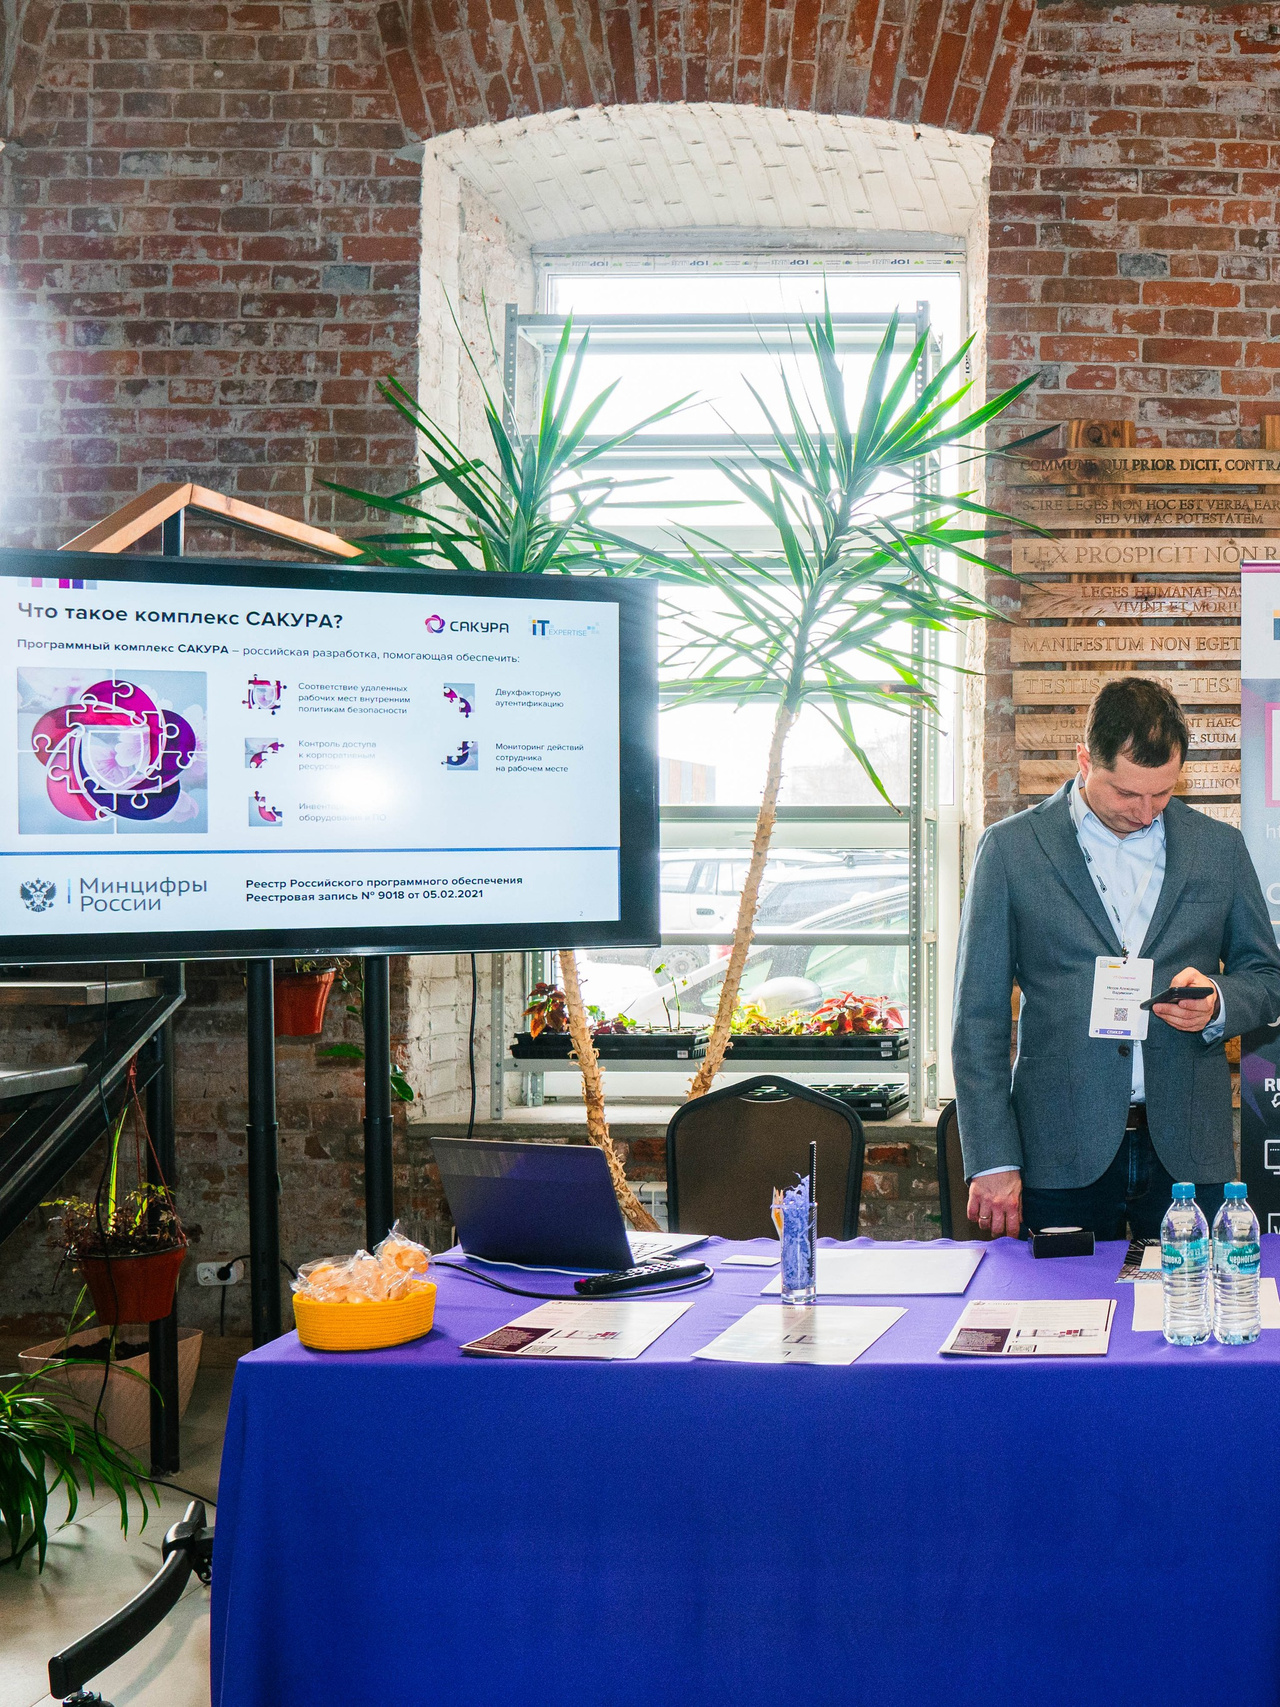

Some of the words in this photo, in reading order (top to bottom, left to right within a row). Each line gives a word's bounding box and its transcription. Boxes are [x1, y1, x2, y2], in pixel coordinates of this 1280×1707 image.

[1132, 459, 1176, 471] PRIOR
[1180, 459, 1222, 473] DICIT,
[1023, 501, 1062, 511] SCIRE
[1066, 500, 1108, 511] LEGES
[1112, 500, 1142, 511] NON
[1147, 499, 1177, 511] HOC
[1180, 499, 1203, 511] EST
[1208, 499, 1250, 511] VERBA
[1095, 513, 1119, 524] SED
[1123, 513, 1150, 524] VIM
[1154, 513, 1173, 524] AC
[1176, 512, 1264, 525] POTESTATEM
[1022, 546, 1068, 564] LEX
[1074, 546, 1198, 564] PROSPICIT
[1205, 546, 1257, 564] NON
[18, 602, 58, 618] Что
[65, 606, 128, 621] такое
[136, 609, 239, 626] комплекс
[246, 611, 343, 629] САКУРА?
[450, 620, 509, 634] САКУРА
[549, 628, 587, 637] EXPERTISE
[1022, 637, 1144, 651] MANIFESTUM
[1150, 637, 1192, 651] NON
[1196, 637, 1241, 651] EGET
[17, 639, 110, 651] Программный
[114, 643, 174, 653] комплекс
[178, 644, 229, 654] САКУРА
[243, 646, 309, 657] российская
[313, 649, 380, 660] разработка,
[383, 651, 453, 662] помогающая
[456, 652, 520, 663] обеспечить:
[298, 683, 358, 692] Соответствие
[361, 684, 408, 693] удаленных
[495, 688, 561, 698] Двухфакторную
[298, 694, 335, 703] рабочих
[337, 695, 357, 703] мест
[360, 696, 411, 704] внутренним
[495, 700, 564, 709] аутентификацию
[347, 706, 407, 714] безопасности
[495, 743, 545, 752] Мониторинг
[547, 742, 584, 752] действий
[495, 754, 542, 763] сотрудника
[507, 764, 543, 773] рабочем
[545, 765, 569, 773] месте
[80, 877, 207, 896] Минцифры
[246, 880, 287, 890] Реестр
[290, 878, 363, 889] Российского
[367, 877, 448, 889] программного
[451, 875, 523, 886] обеспечения
[246, 893, 315, 904] Реестровая
[318, 892, 358, 901] запись
[378, 890, 405, 899] 9018
[423, 889, 483, 899] 05.02.2021
[81, 896, 161, 911] России
